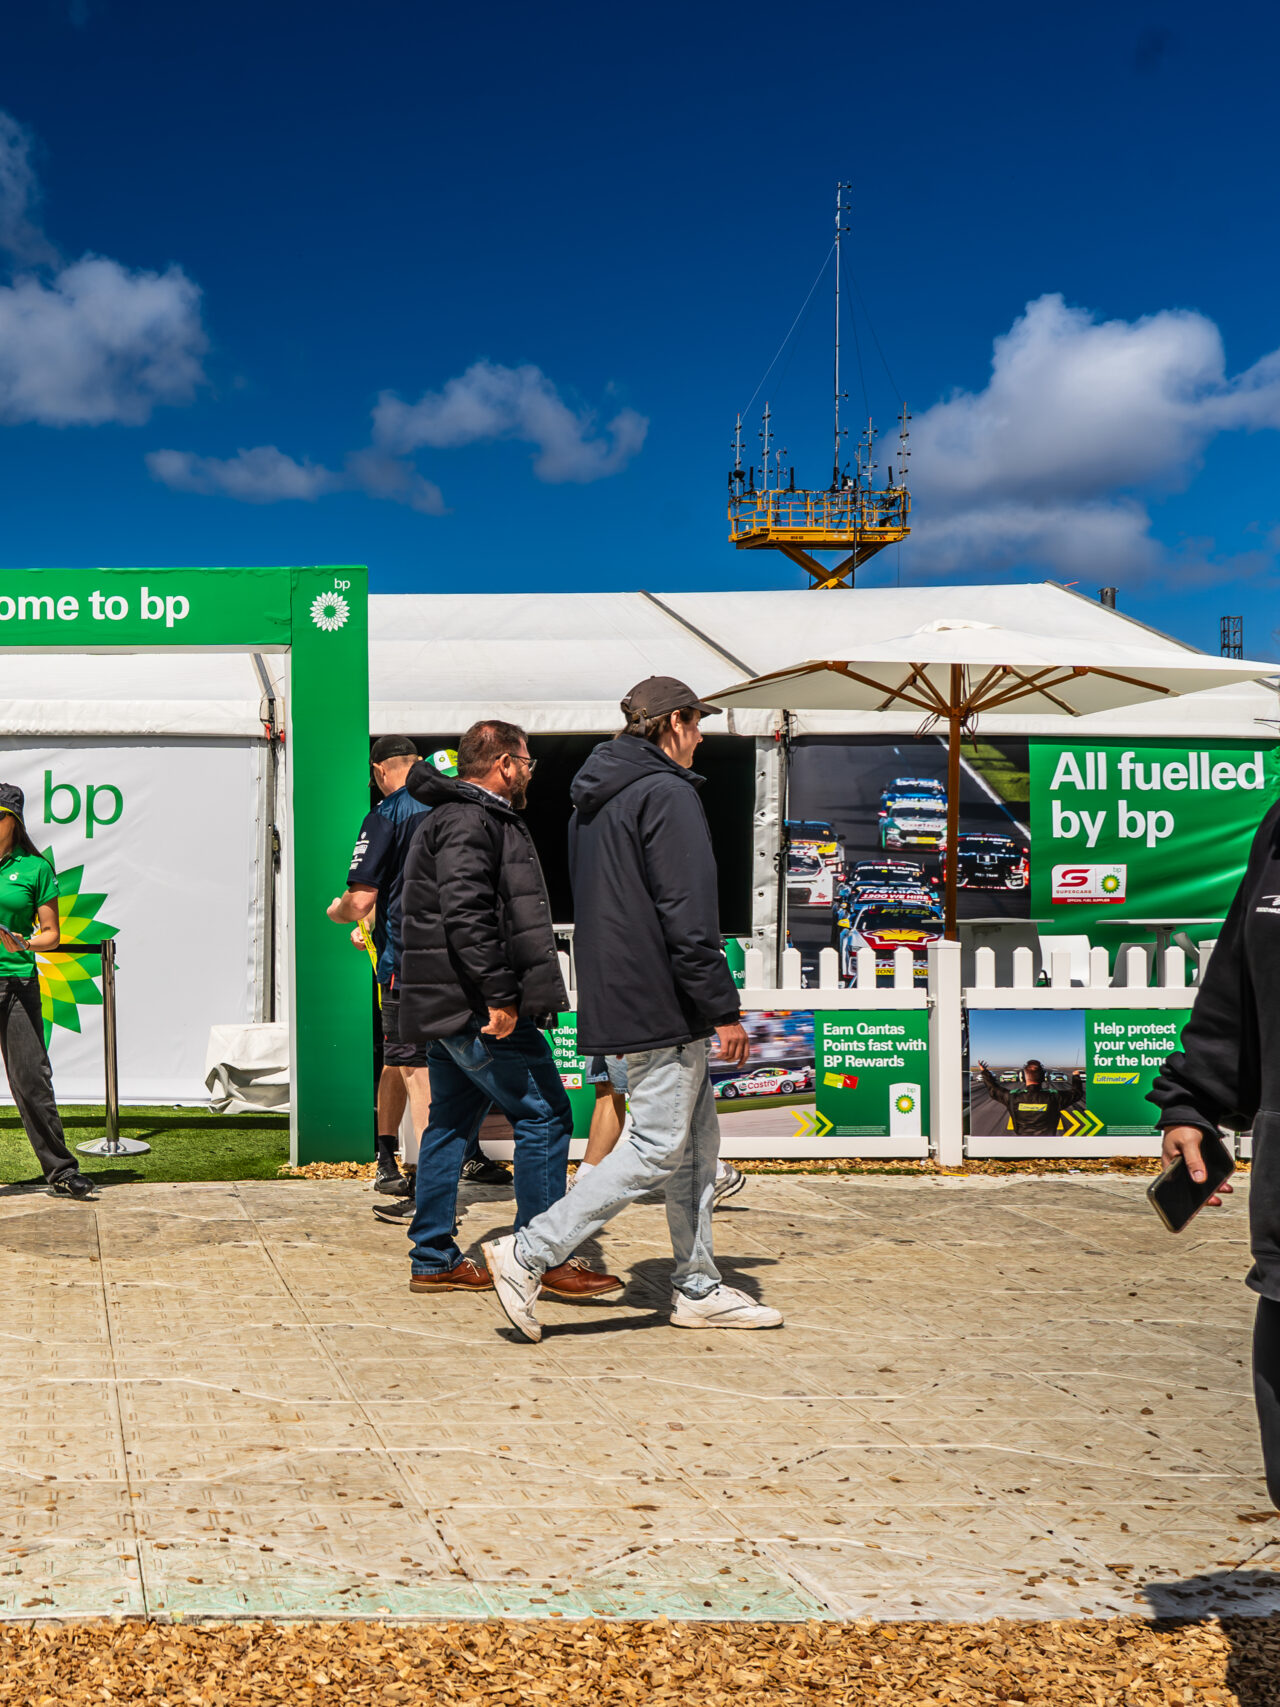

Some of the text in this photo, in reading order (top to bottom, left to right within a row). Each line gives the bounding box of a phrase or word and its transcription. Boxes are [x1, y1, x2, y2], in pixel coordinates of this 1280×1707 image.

[334, 577, 351, 592] bp
[87, 590, 129, 621] to
[140, 586, 191, 628] bp
[1049, 751, 1266, 791] All fuelled
[43, 769, 124, 839] bp
[1051, 799, 1175, 848] by bp
[823, 1022, 906, 1037] Earn Qantas
[1093, 1022, 1177, 1038] Help protect
[823, 1038, 928, 1052] Points fast with
[1093, 1037, 1175, 1054] your vehicle
[823, 1054, 905, 1068] BP Rewards
[1093, 1054, 1114, 1067] for
[1115, 1054, 1139, 1067] the
[747, 1079, 778, 1090] Castrol
